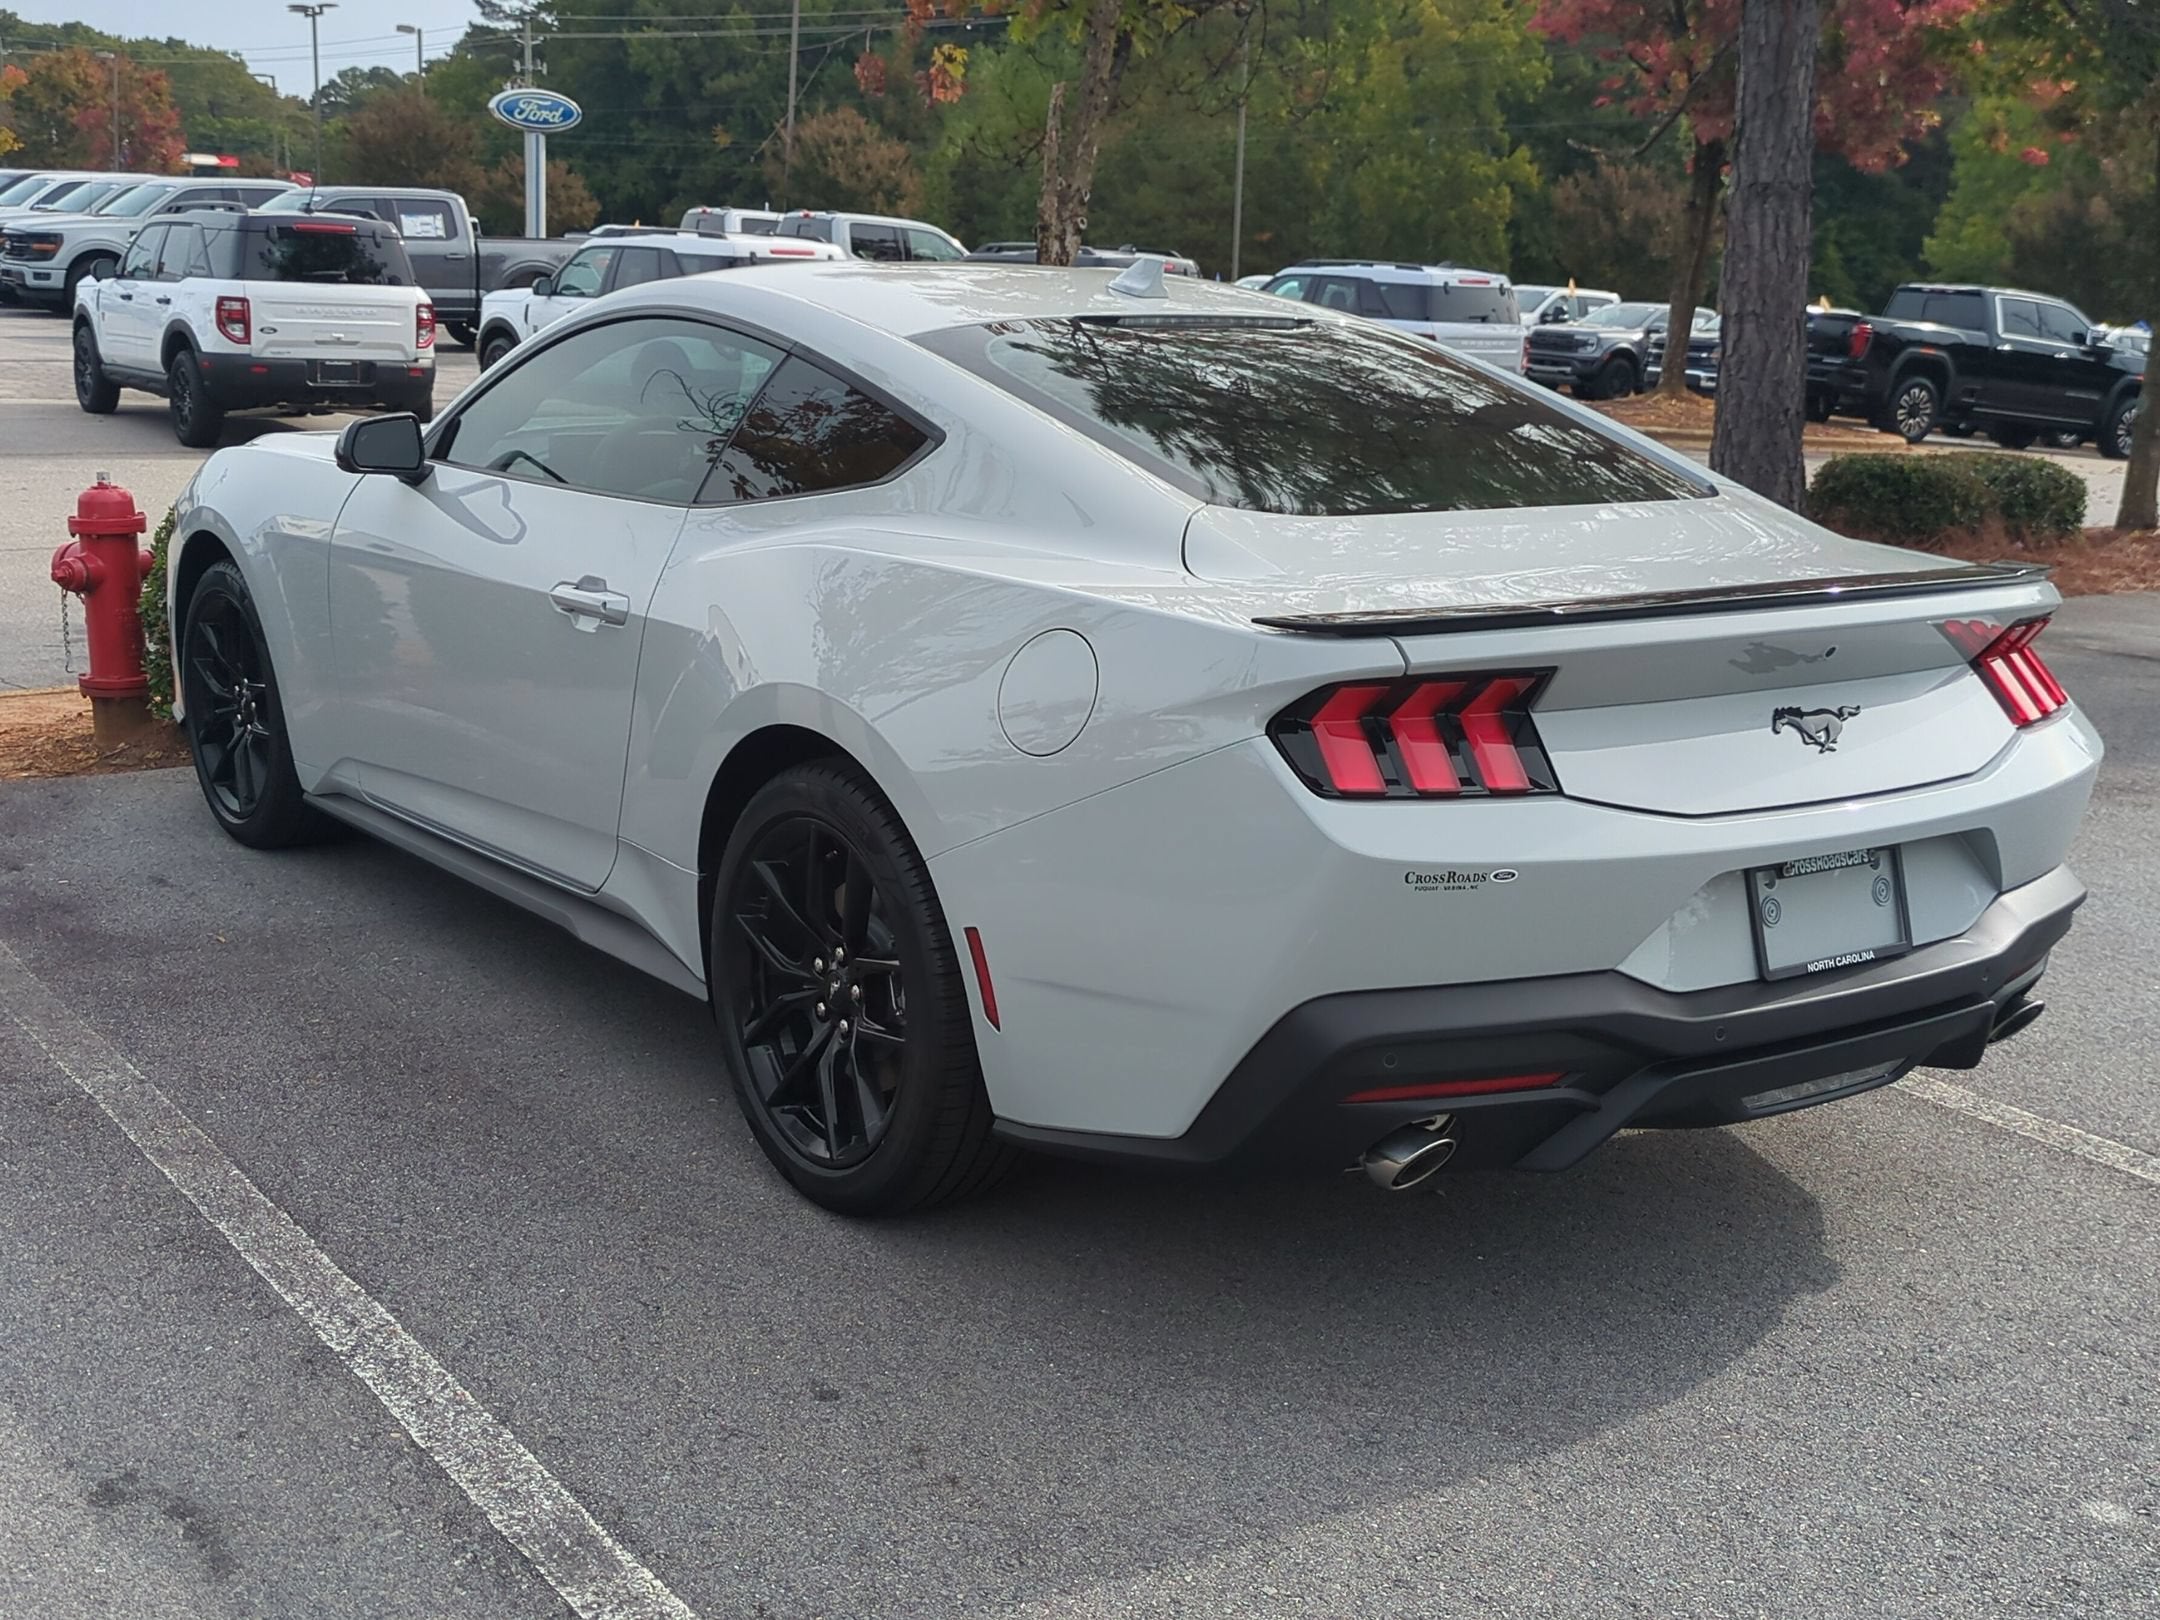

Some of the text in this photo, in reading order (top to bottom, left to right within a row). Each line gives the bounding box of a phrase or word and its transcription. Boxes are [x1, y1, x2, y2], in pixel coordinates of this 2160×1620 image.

[514, 98, 564, 122] Ford
[1807, 950, 1875, 973] NORTH CAROLINA
